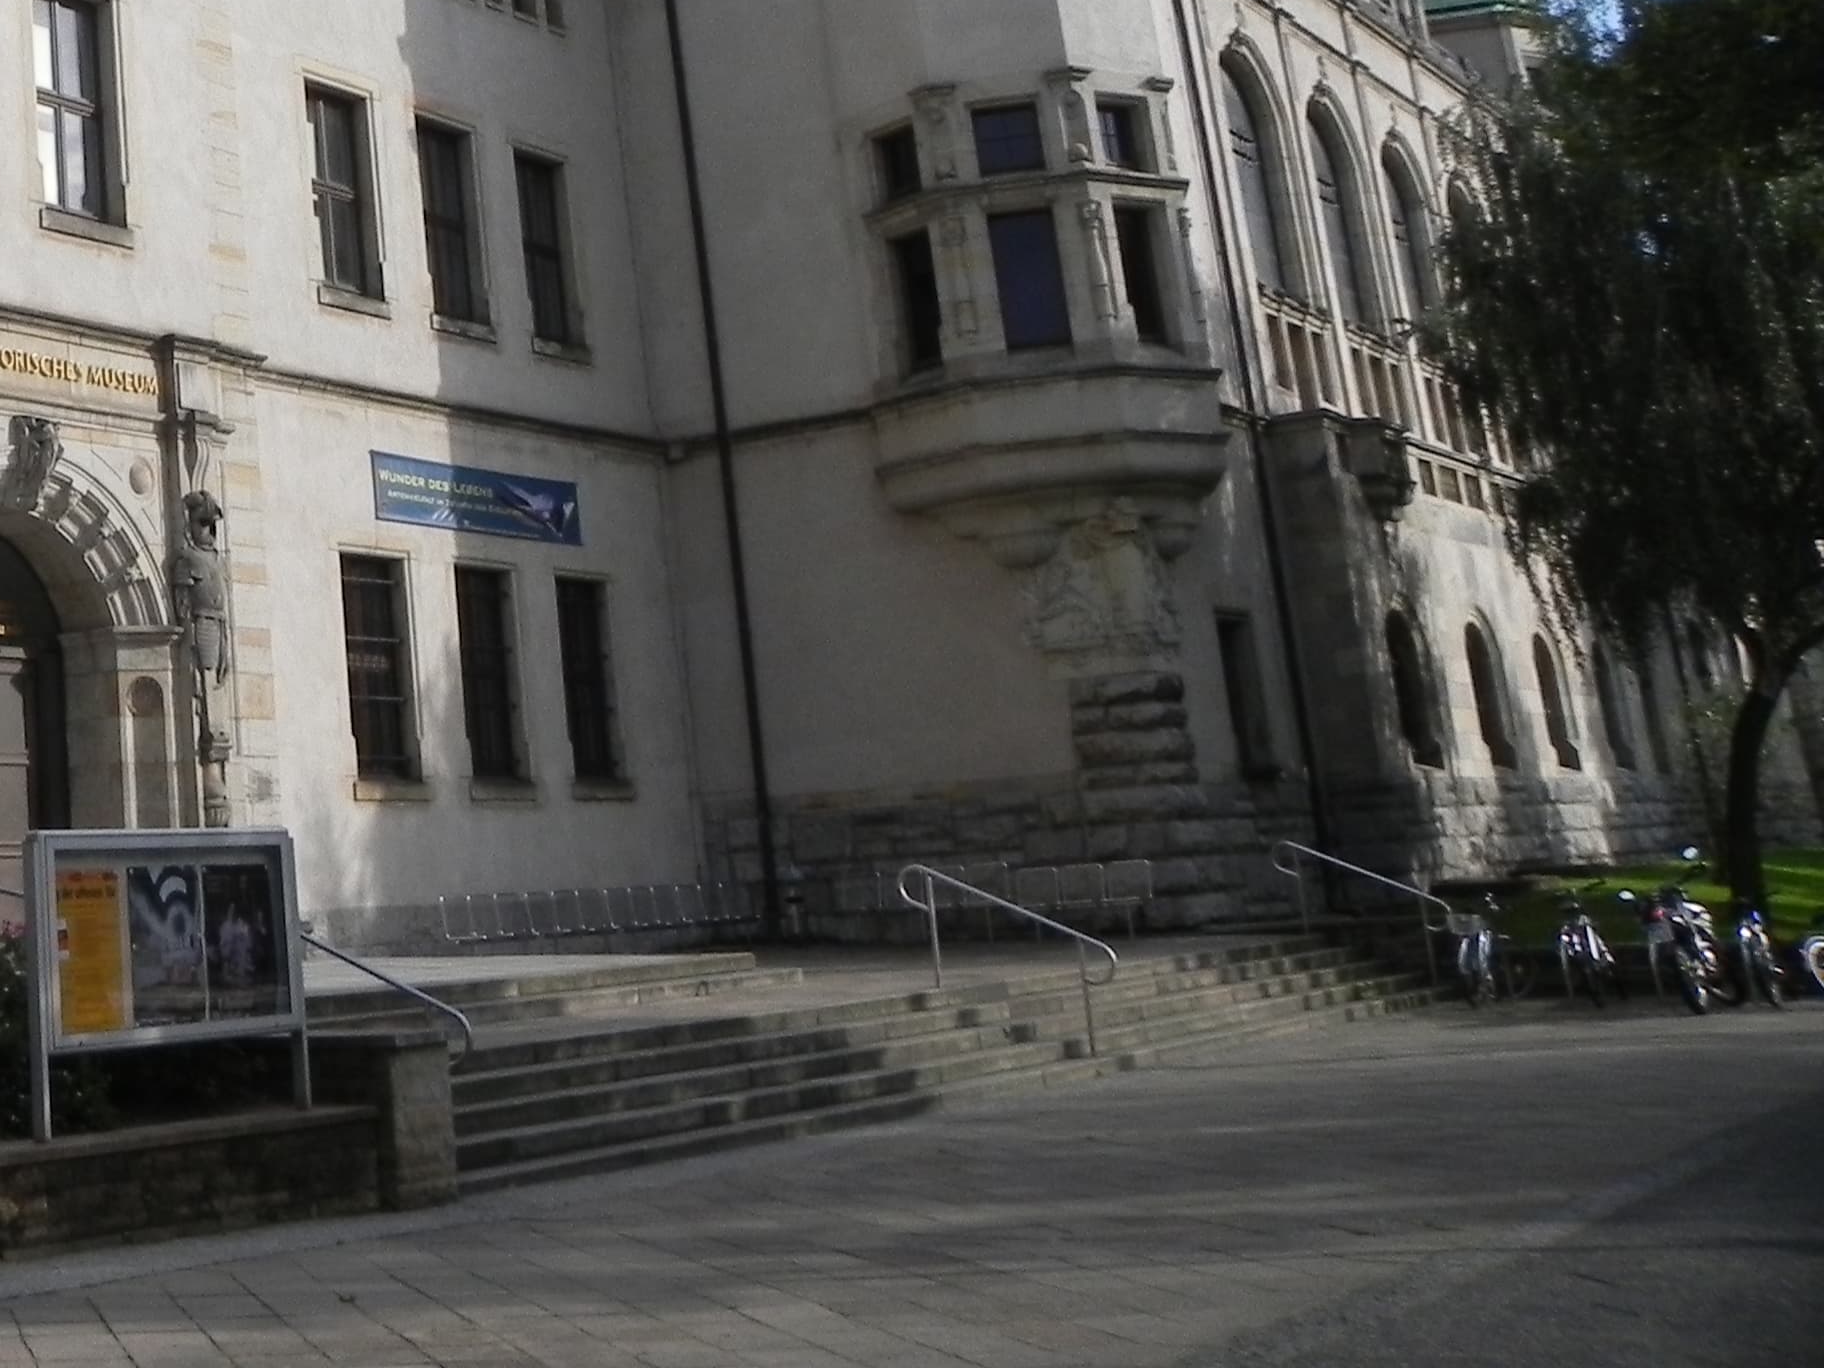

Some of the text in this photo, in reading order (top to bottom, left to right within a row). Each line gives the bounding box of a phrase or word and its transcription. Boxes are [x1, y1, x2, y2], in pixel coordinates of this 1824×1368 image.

[85, 365, 161, 397] MUSEUM
[378, 468, 425, 487] WUNDER
[427, 478, 450, 492] DES
